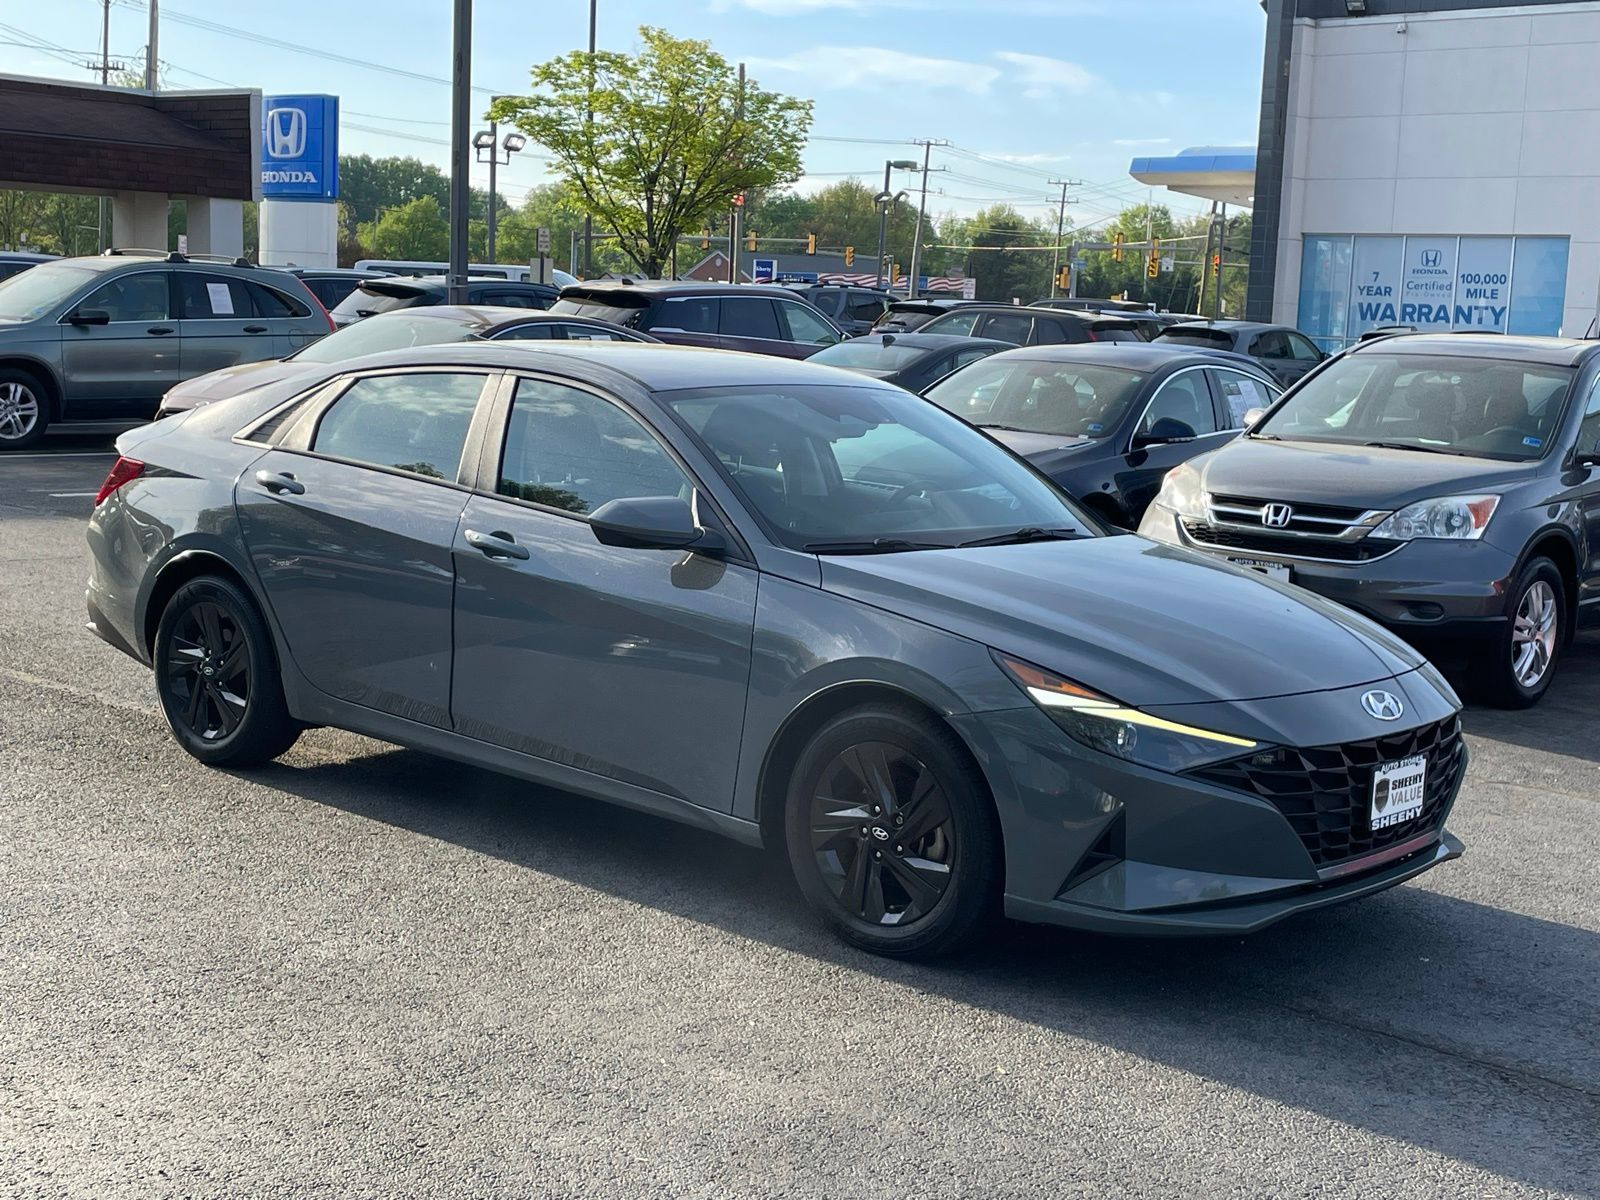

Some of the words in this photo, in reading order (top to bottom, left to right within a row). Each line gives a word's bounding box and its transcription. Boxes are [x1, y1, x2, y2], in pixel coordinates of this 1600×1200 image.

[261, 171, 318, 183] HONDA
[1372, 271, 1380, 283] 7
[1460, 273, 1507, 285] 100,000
[1358, 285, 1393, 297] YEAR
[1406, 280, 1453, 291] Certified
[1466, 288, 1499, 300] MILE
[1358, 302, 1507, 326] WARRANTY
[1380, 762, 1399, 773] AUTO
[1391, 772, 1424, 790] SHEEHY
[1391, 785, 1422, 806] VALUE
[1371, 805, 1423, 831] SHEEHY
